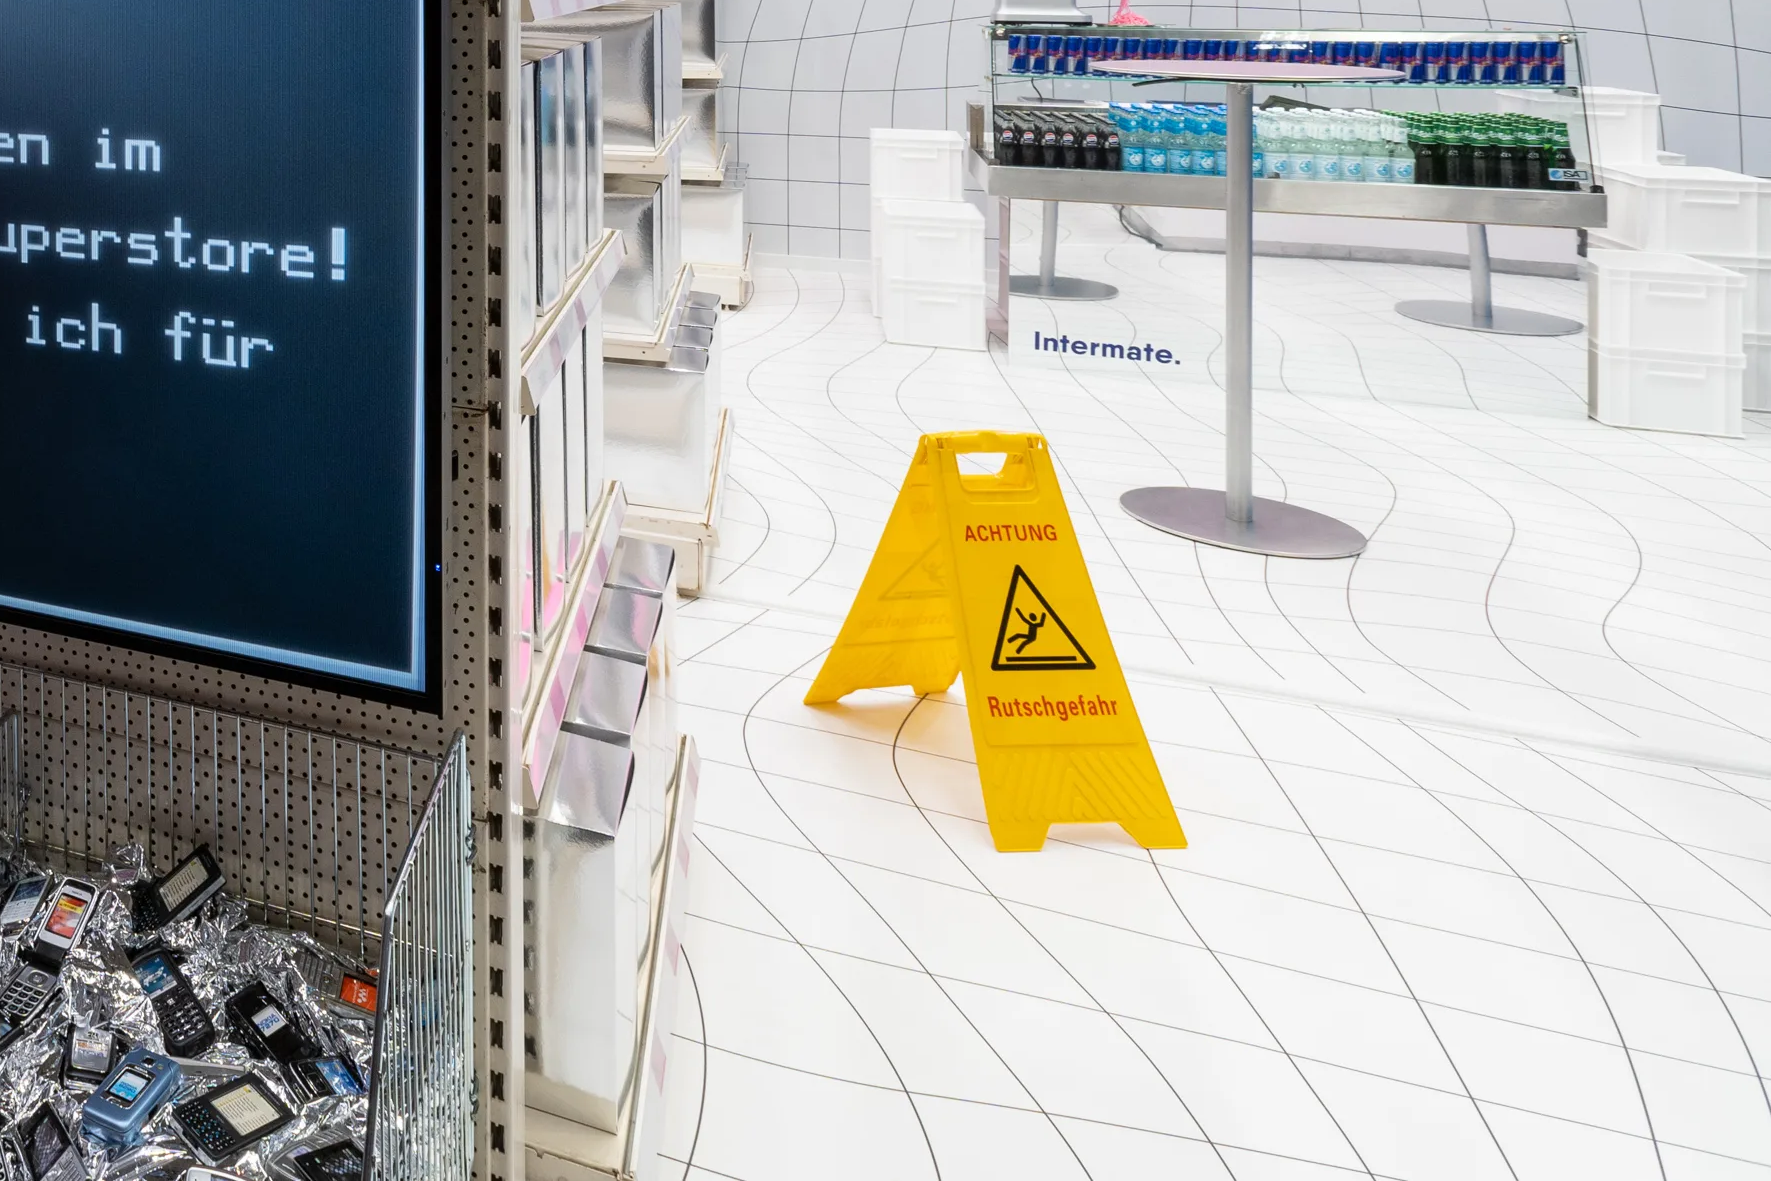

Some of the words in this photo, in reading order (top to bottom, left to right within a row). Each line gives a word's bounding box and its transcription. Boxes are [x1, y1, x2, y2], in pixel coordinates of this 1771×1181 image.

[95, 128, 161, 172] im
[26, 303, 123, 354] ich
[164, 311, 274, 369] für
[1034, 331, 1181, 366] Intermate.
[964, 523, 1058, 543] ACHTUNG
[987, 694, 1118, 722] Rutschgefahr
